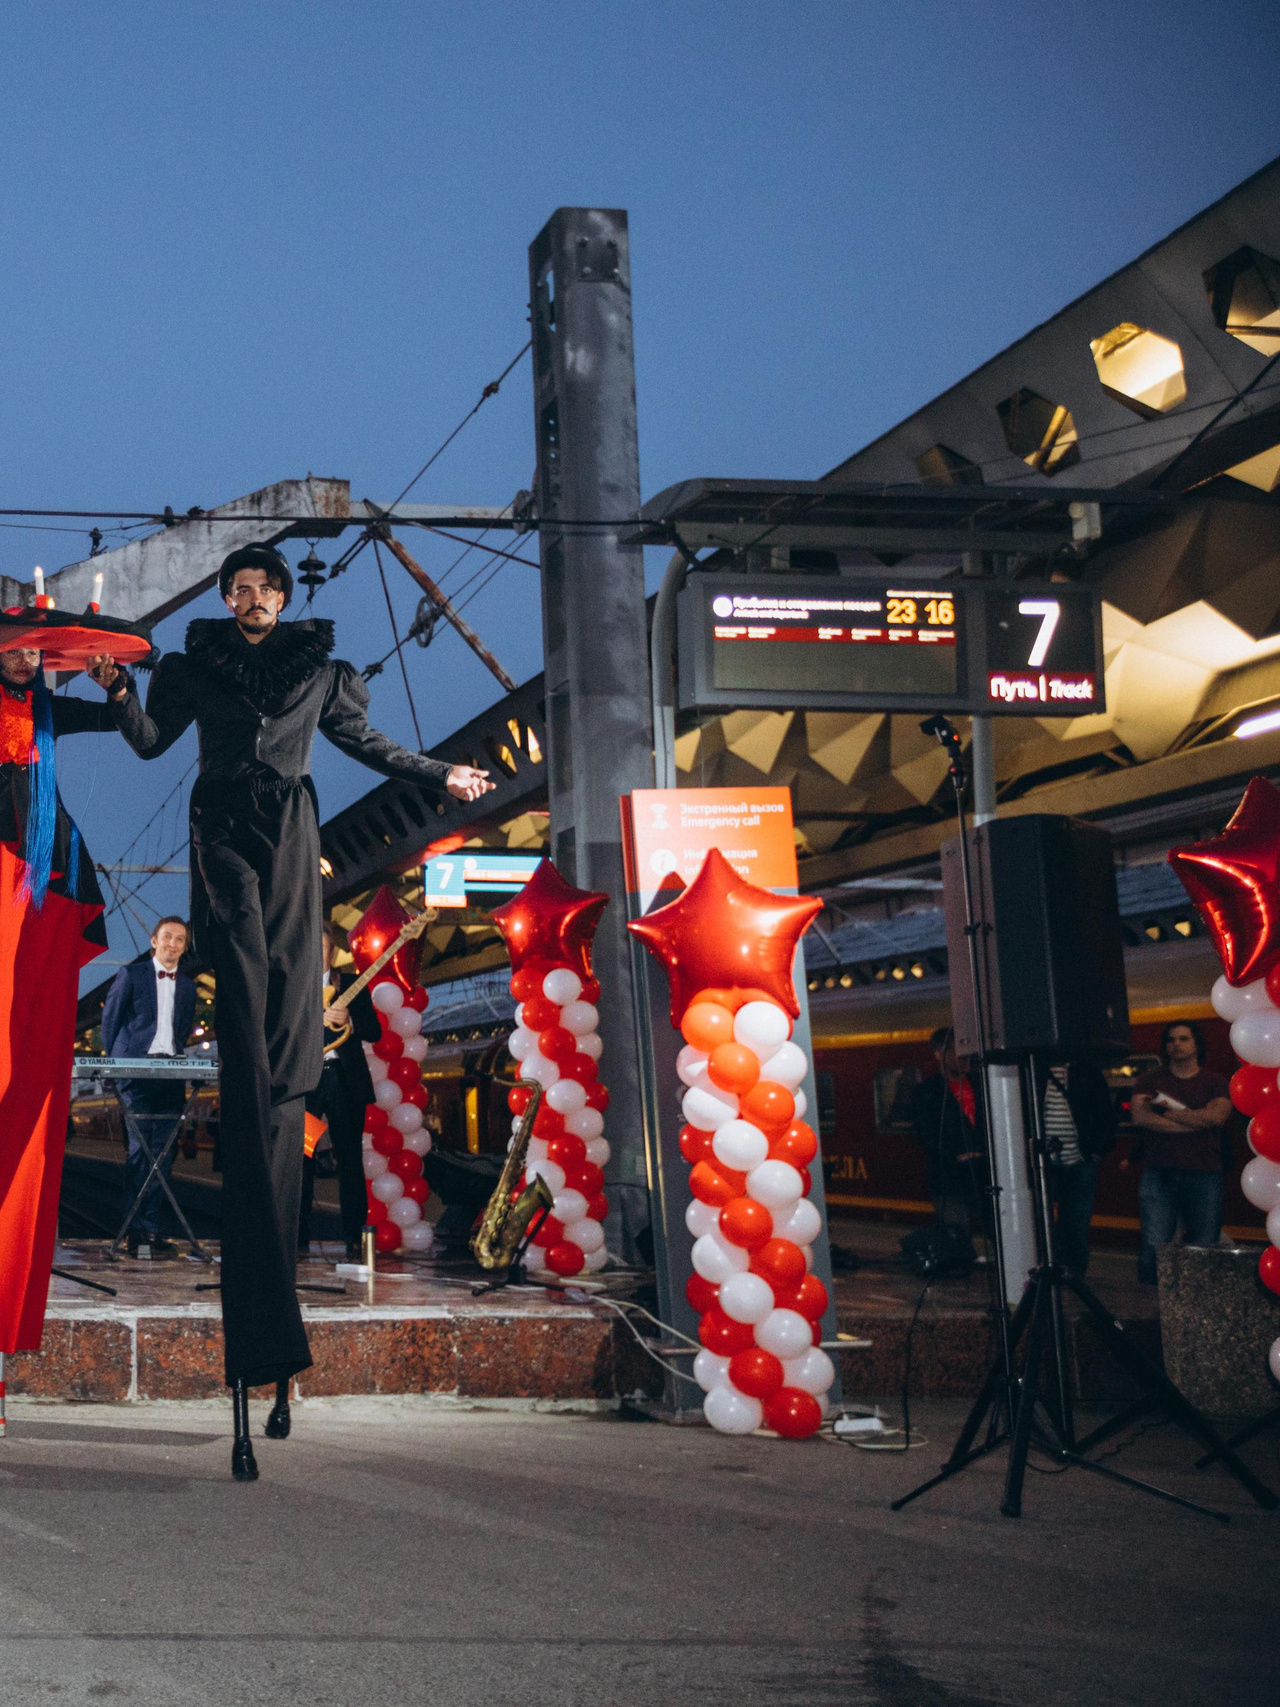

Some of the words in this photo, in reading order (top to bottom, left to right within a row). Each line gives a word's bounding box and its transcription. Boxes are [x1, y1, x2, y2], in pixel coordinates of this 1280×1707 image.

[886, 599, 918, 624] 23
[924, 600, 955, 625] 16
[1018, 601, 1061, 667] 7
[990, 677, 1038, 702] Путь
[1048, 679, 1093, 699] Track
[680, 803, 748, 815] Экстренный
[750, 804, 785, 813] вызов
[681, 817, 740, 829] Emergency
[742, 816, 761, 826] call
[683, 849, 758, 859] Инфмация
[436, 862, 454, 889] 7
[87, 1058, 116, 1066] YAMAHA
